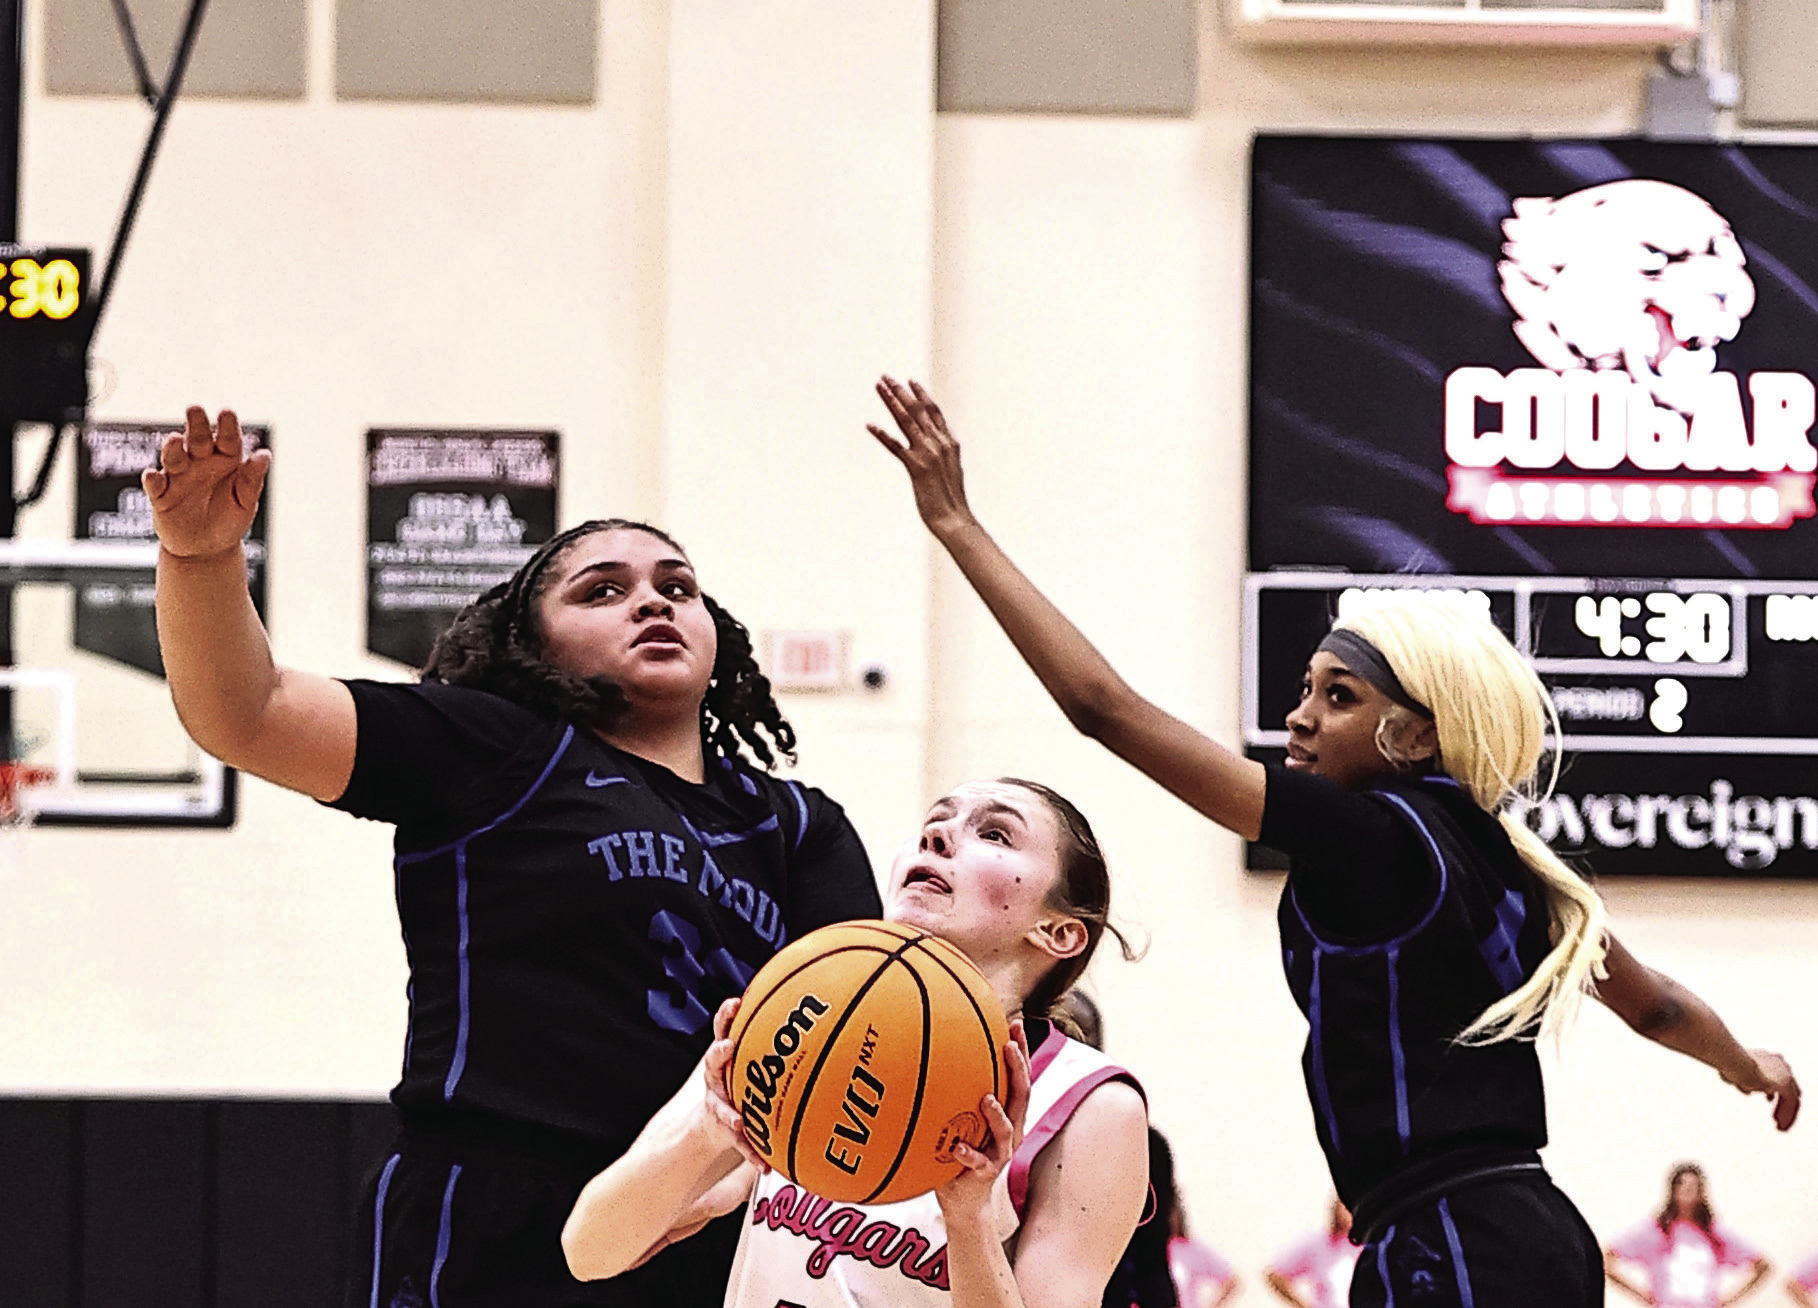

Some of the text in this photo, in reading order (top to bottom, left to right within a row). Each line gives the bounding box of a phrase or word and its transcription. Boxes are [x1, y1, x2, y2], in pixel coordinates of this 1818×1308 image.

[1445, 366, 1817, 473] COUGAR
[1575, 592, 1730, 664] 4:30
[1650, 678, 1688, 734] 2
[1510, 779, 1818, 870] overeign
[587, 831, 787, 951] THE MOU
[742, 994, 831, 1157] Wilson
[858, 1023, 879, 1066] NXT
[752, 1184, 951, 1291] ougars
